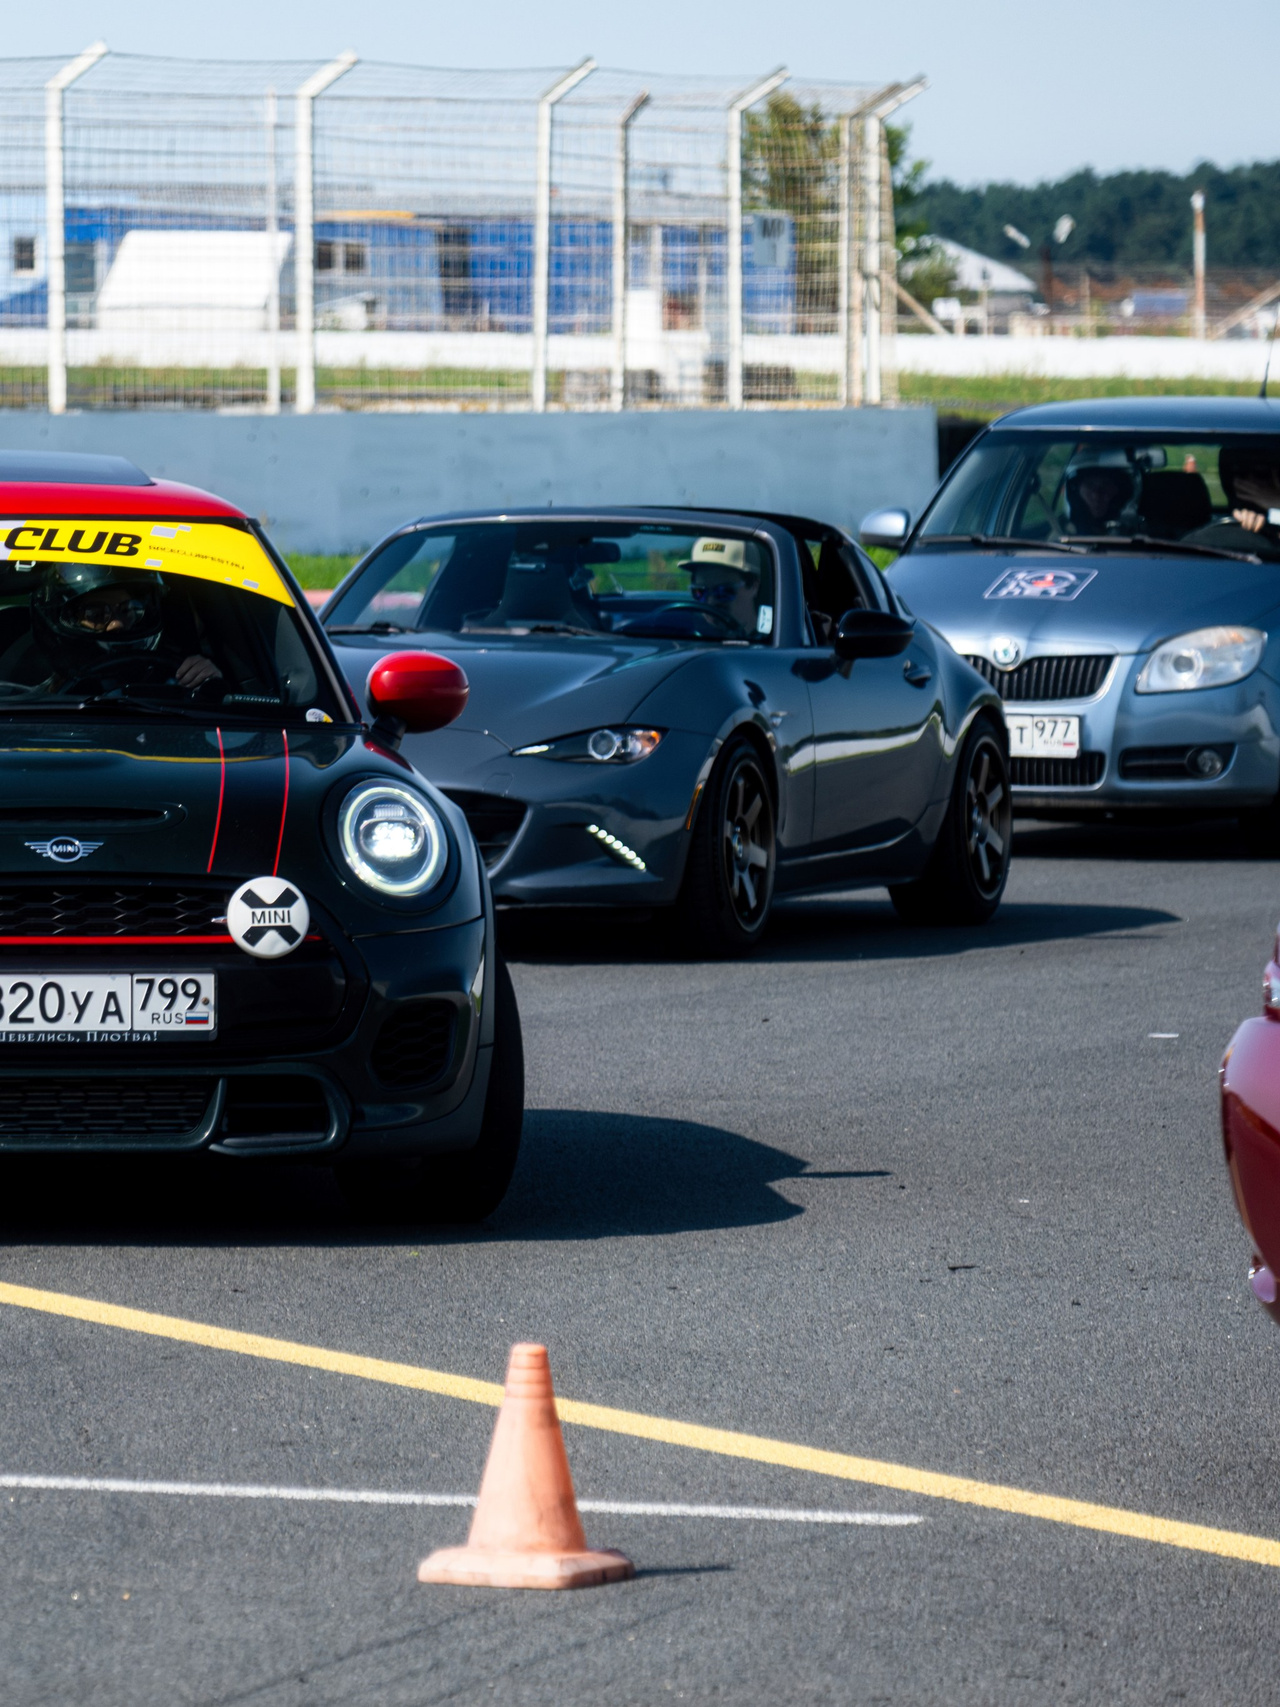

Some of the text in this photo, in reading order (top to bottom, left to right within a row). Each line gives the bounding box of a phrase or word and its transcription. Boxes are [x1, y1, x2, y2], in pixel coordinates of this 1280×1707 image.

[4, 527, 142, 557] CLUB
[1034, 719, 1071, 739] 977
[51, 844, 79, 853] MINI
[251, 909, 291, 925] MINI
[135, 977, 202, 1011] 799
[151, 1011, 184, 1024] RUS
